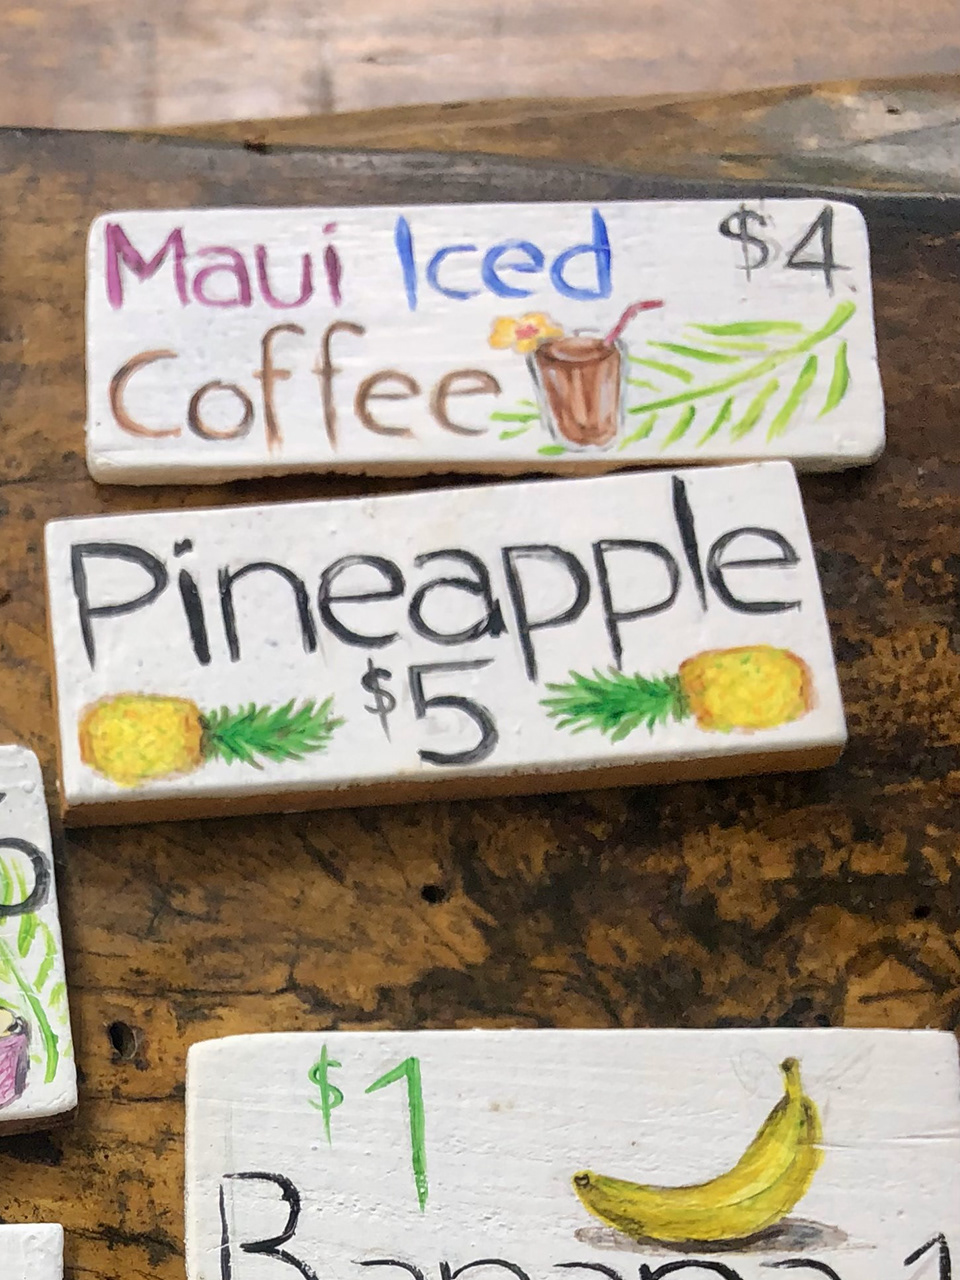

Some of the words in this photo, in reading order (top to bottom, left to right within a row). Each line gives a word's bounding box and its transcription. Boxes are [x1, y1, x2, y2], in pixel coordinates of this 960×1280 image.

[104, 223, 342, 310] Maui
[395, 208, 613, 310] Iced
[719, 204, 856, 299] $4
[110, 322, 501, 450] Coffee
[71, 476, 801, 682] Pineapple
[361, 658, 499, 766] $5
[308, 1044, 429, 1212] $1
